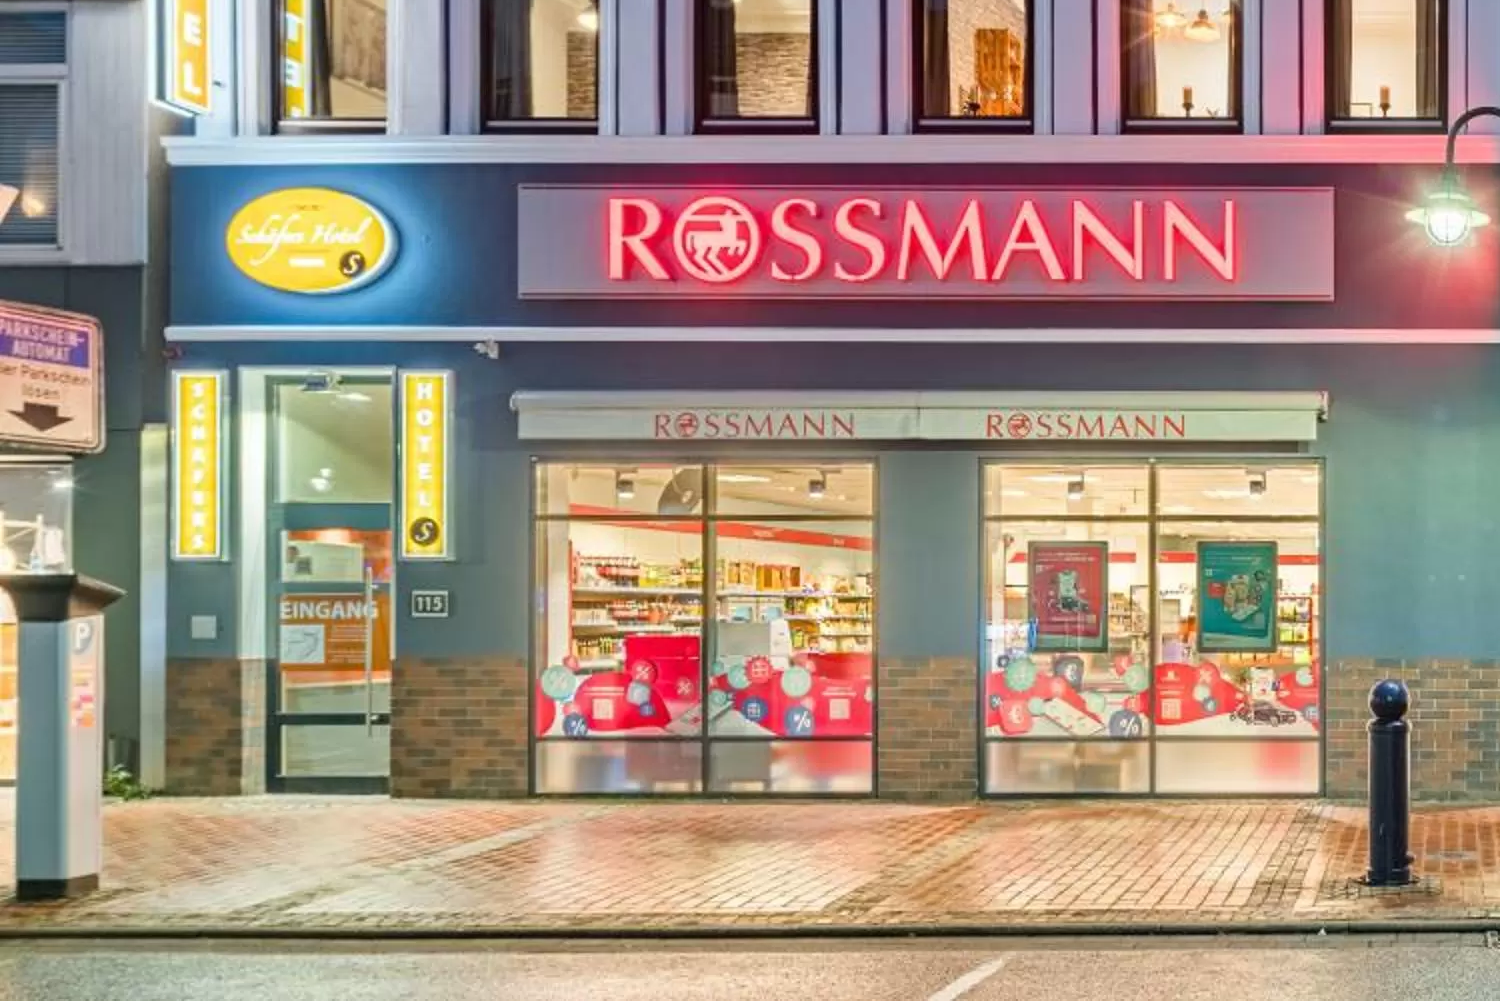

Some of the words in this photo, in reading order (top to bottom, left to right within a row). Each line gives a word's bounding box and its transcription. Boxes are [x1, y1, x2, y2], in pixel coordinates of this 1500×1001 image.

[311, 216, 373, 244] Hotel
[608, 195, 1236, 282] ROSSMANN
[12, 338, 70, 363] AUTOMAT
[655, 412, 855, 438] ROSSMANN
[986, 412, 1185, 438] ROSSMANN
[416, 382, 434, 507] HOTEL
[280, 600, 378, 619] EINGANG
[416, 596, 443, 612] 115
